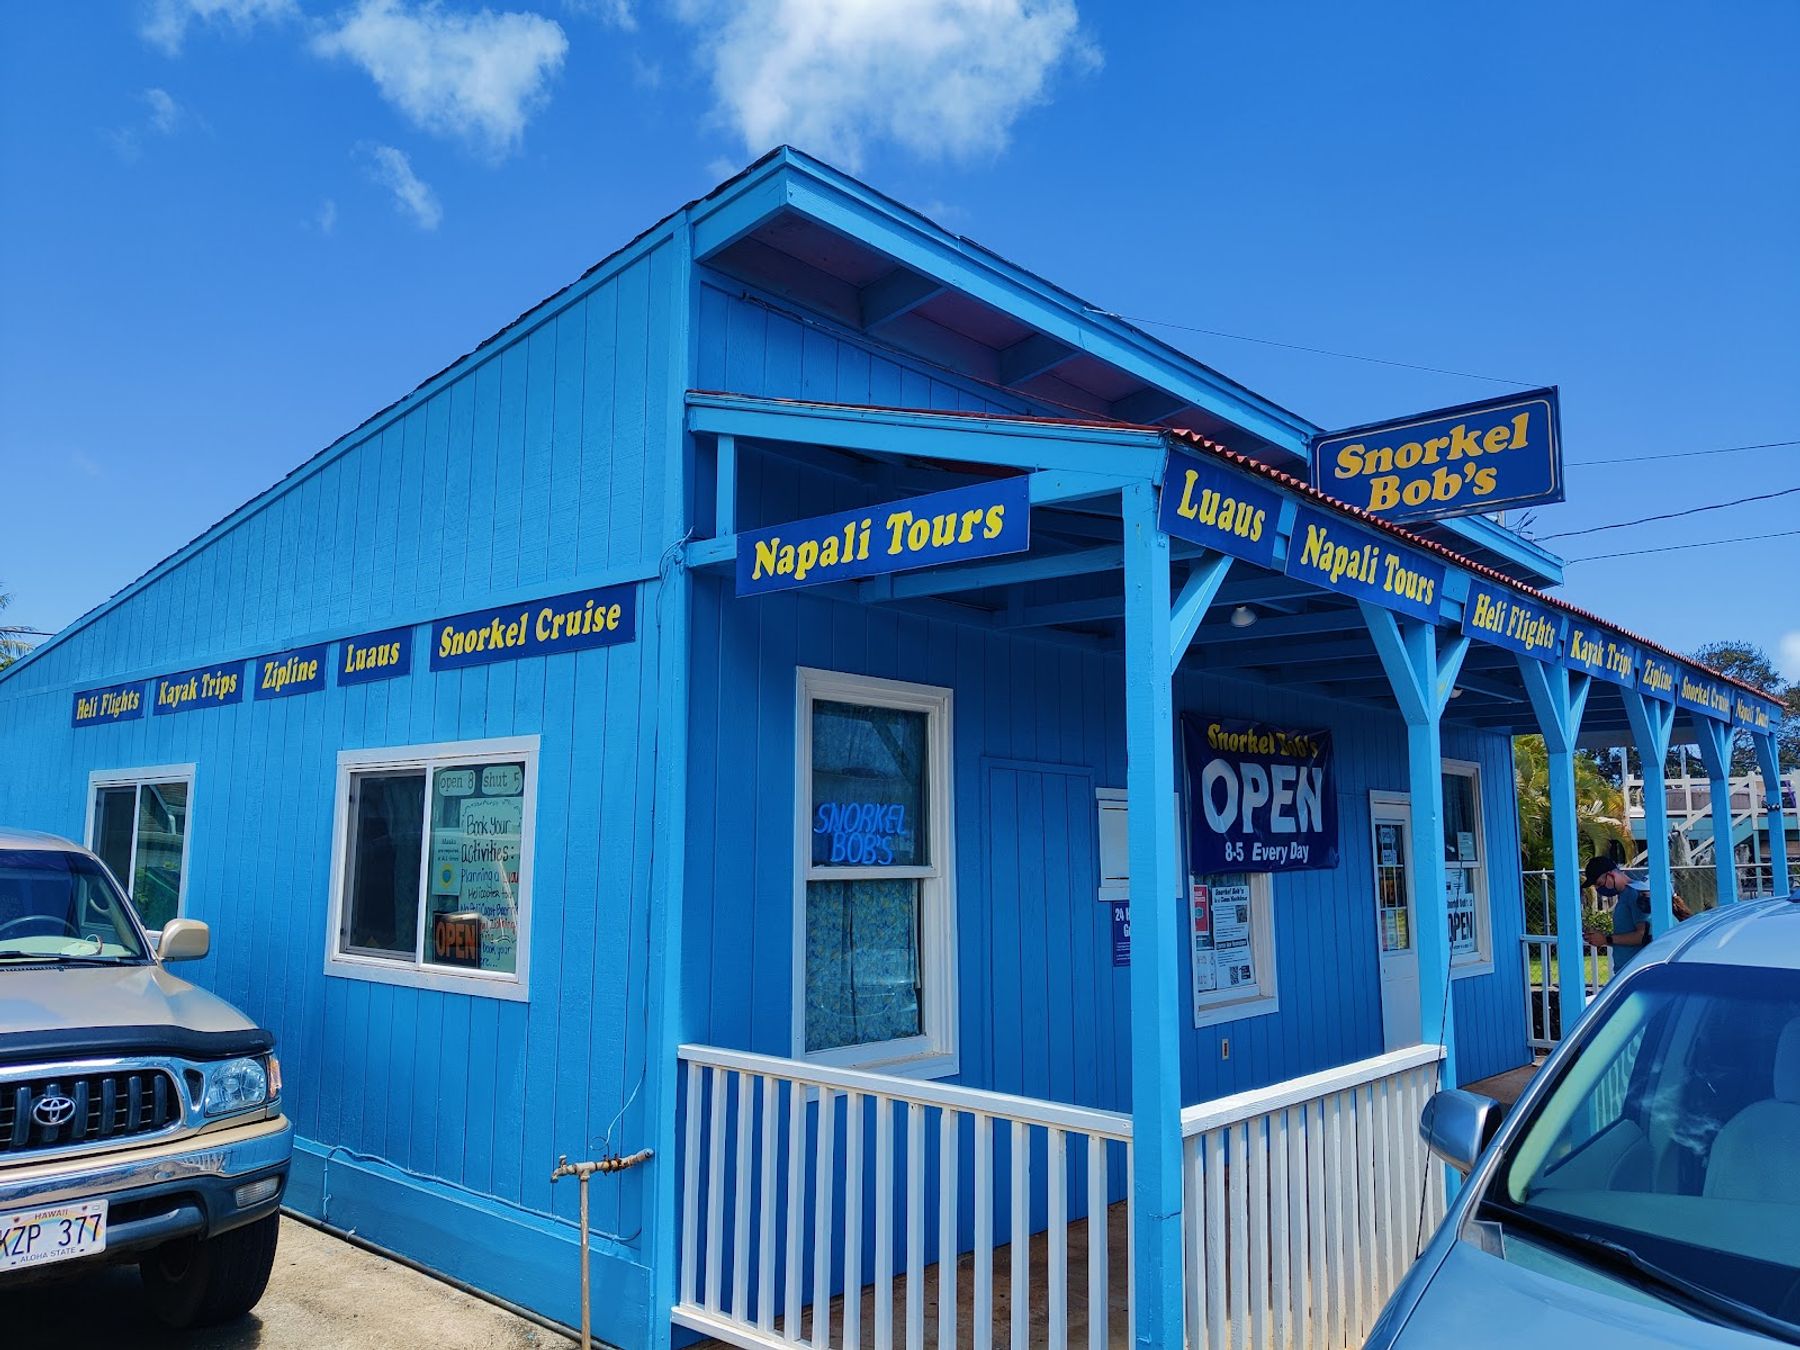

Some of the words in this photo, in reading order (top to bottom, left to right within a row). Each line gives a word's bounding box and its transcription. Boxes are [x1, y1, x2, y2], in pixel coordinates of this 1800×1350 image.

[1334, 412, 1530, 480] Snorkel
[1366, 461, 1498, 512] Bob's
[1177, 469, 1266, 543] Luaus
[752, 518, 872, 581] Napali
[886, 504, 1005, 555] Tours
[1300, 524, 1379, 585] Napali
[1384, 553, 1435, 606] Tours
[439, 613, 529, 658] Snorkel
[536, 600, 622, 642] Cruise
[1472, 593, 1508, 633] Heli
[1506, 605, 1556, 650] Flights
[345, 641, 400, 674] Luaus
[1570, 630, 1603, 668] Kayak
[1607, 643, 1633, 680] Trips
[158, 676, 197, 708] Kayak
[201, 671, 237, 701] Trips
[261, 657, 317, 693] Zipline
[1642, 658, 1672, 692] Zipline
[1682, 676, 1710, 706] Snorkel
[76, 696, 98, 720] Heli
[100, 689, 140, 718] Flights
[1207, 723, 1275, 754] Snorkel
[1276, 733, 1319, 758] Bob's
[440, 776, 463, 792] open
[467, 771, 474, 790] 8
[483, 771, 508, 788] shut
[513, 771, 520, 792] 5
[1201, 758, 1323, 834] OPEN
[466, 814, 489, 836] Book
[814, 803, 908, 836] SNORKEL
[830, 832, 895, 865] BOB'S
[1252, 842, 1288, 865] Every
[1290, 841, 1309, 864] Day
[435, 921, 476, 960] OPEN
[34, 1209, 68, 1220] HAWAII
[59, 1213, 102, 1246] 377
[20, 1253, 48, 1263] ALOHA
[50, 1247, 76, 1257] STATE
